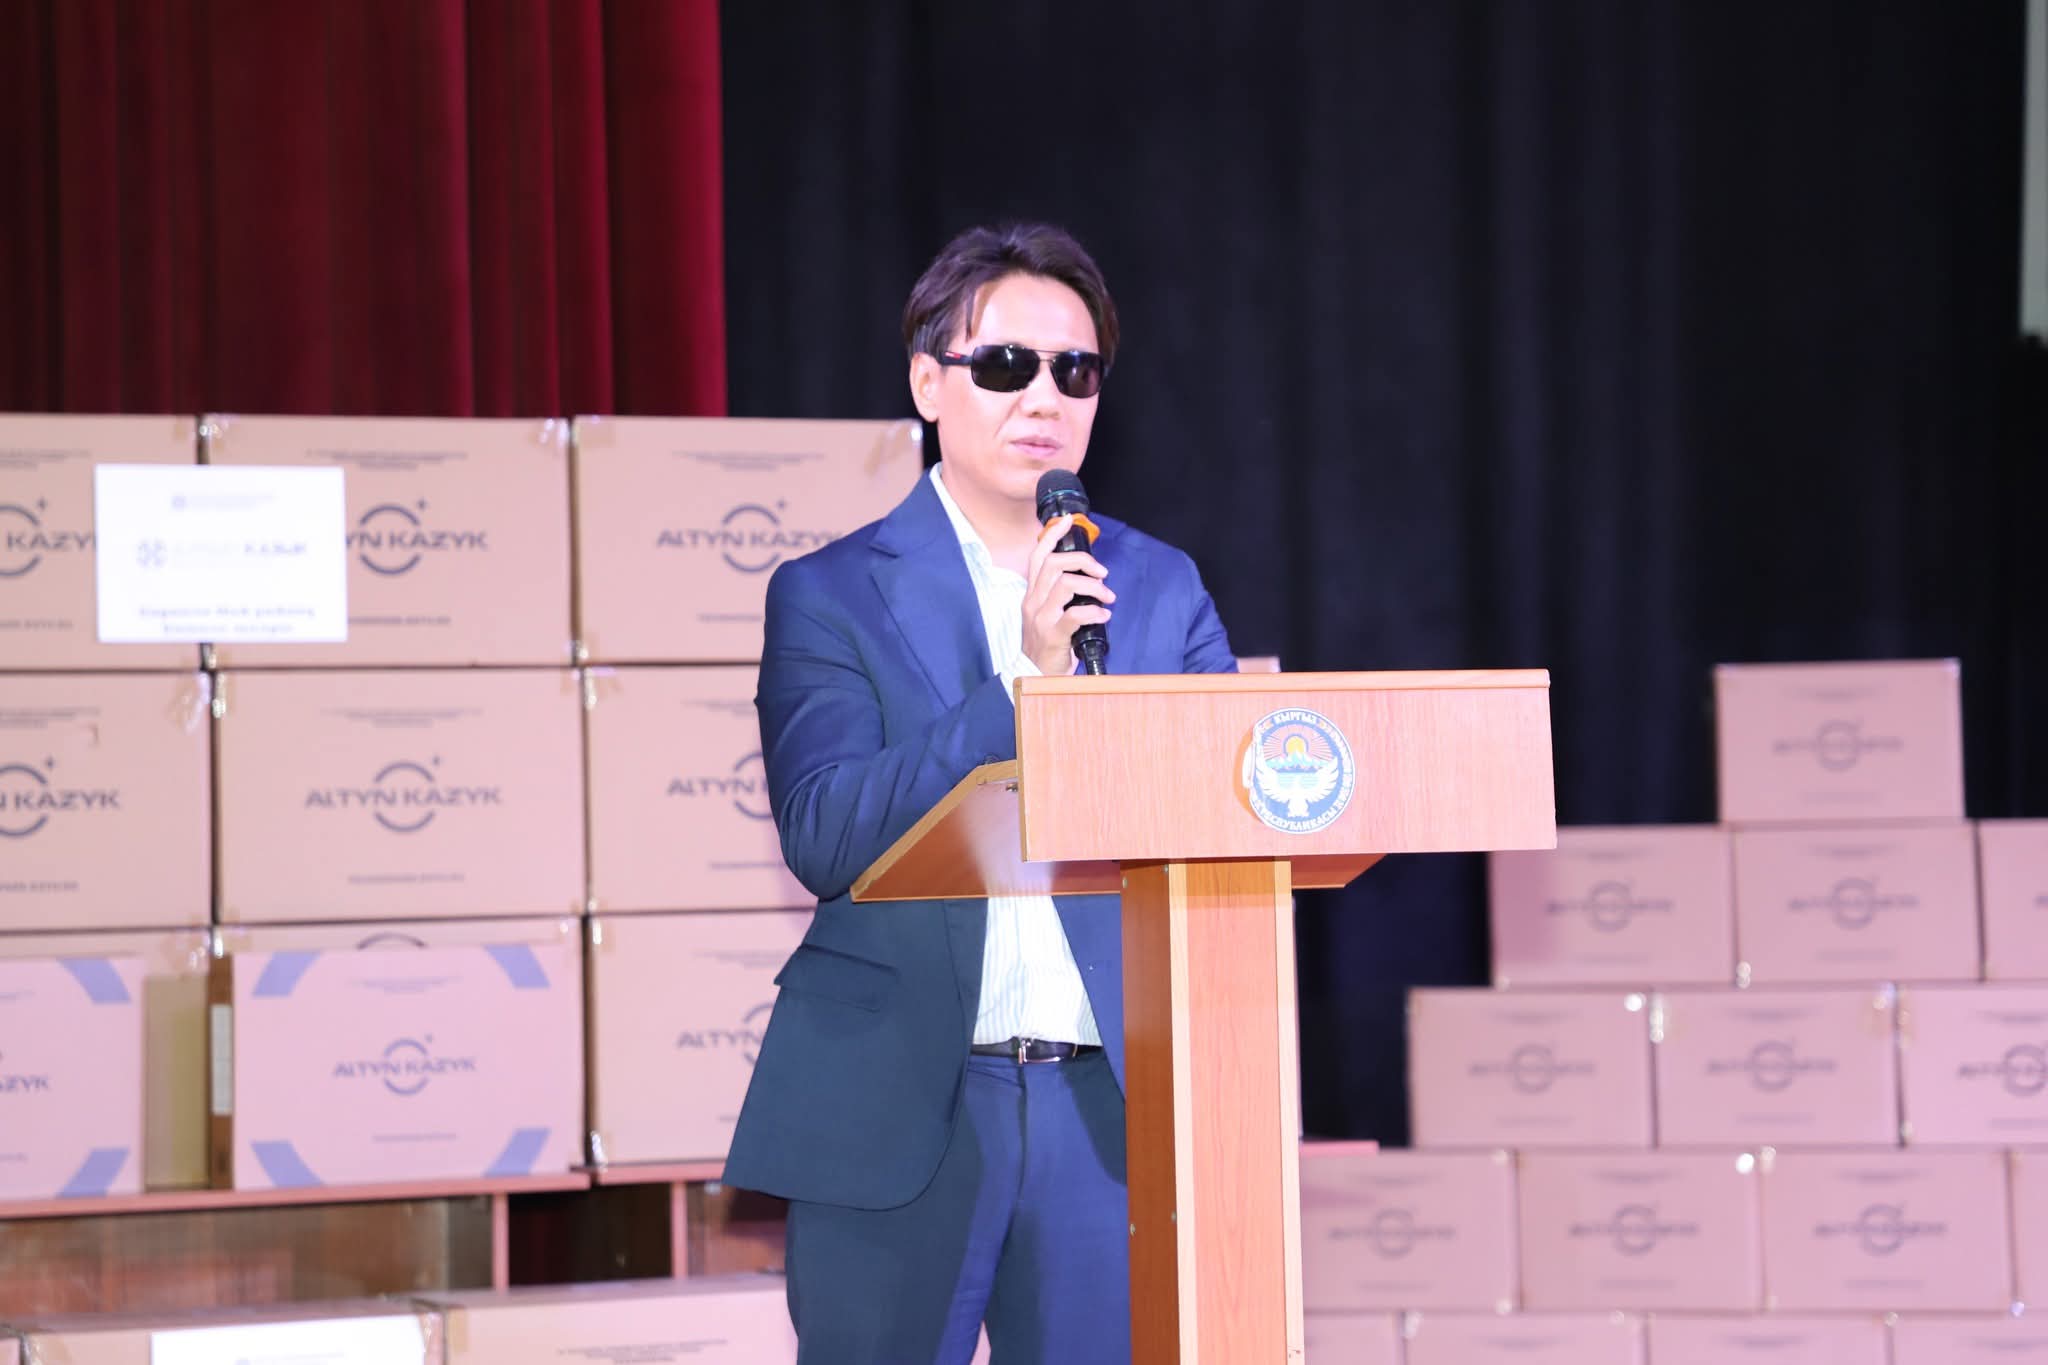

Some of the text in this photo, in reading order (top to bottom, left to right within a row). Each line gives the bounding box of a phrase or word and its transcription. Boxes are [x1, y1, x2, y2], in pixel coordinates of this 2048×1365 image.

[6, 530, 97, 551] KAZY
[389, 530, 489, 550] KAZYK
[656, 529, 746, 548] ALTYN
[305, 785, 502, 809] ALTYN KAZYK
[666, 777, 755, 797] ALTYN
[14, 789, 122, 810] KAZYK
[333, 1055, 477, 1078] ALTYN KAZYK
